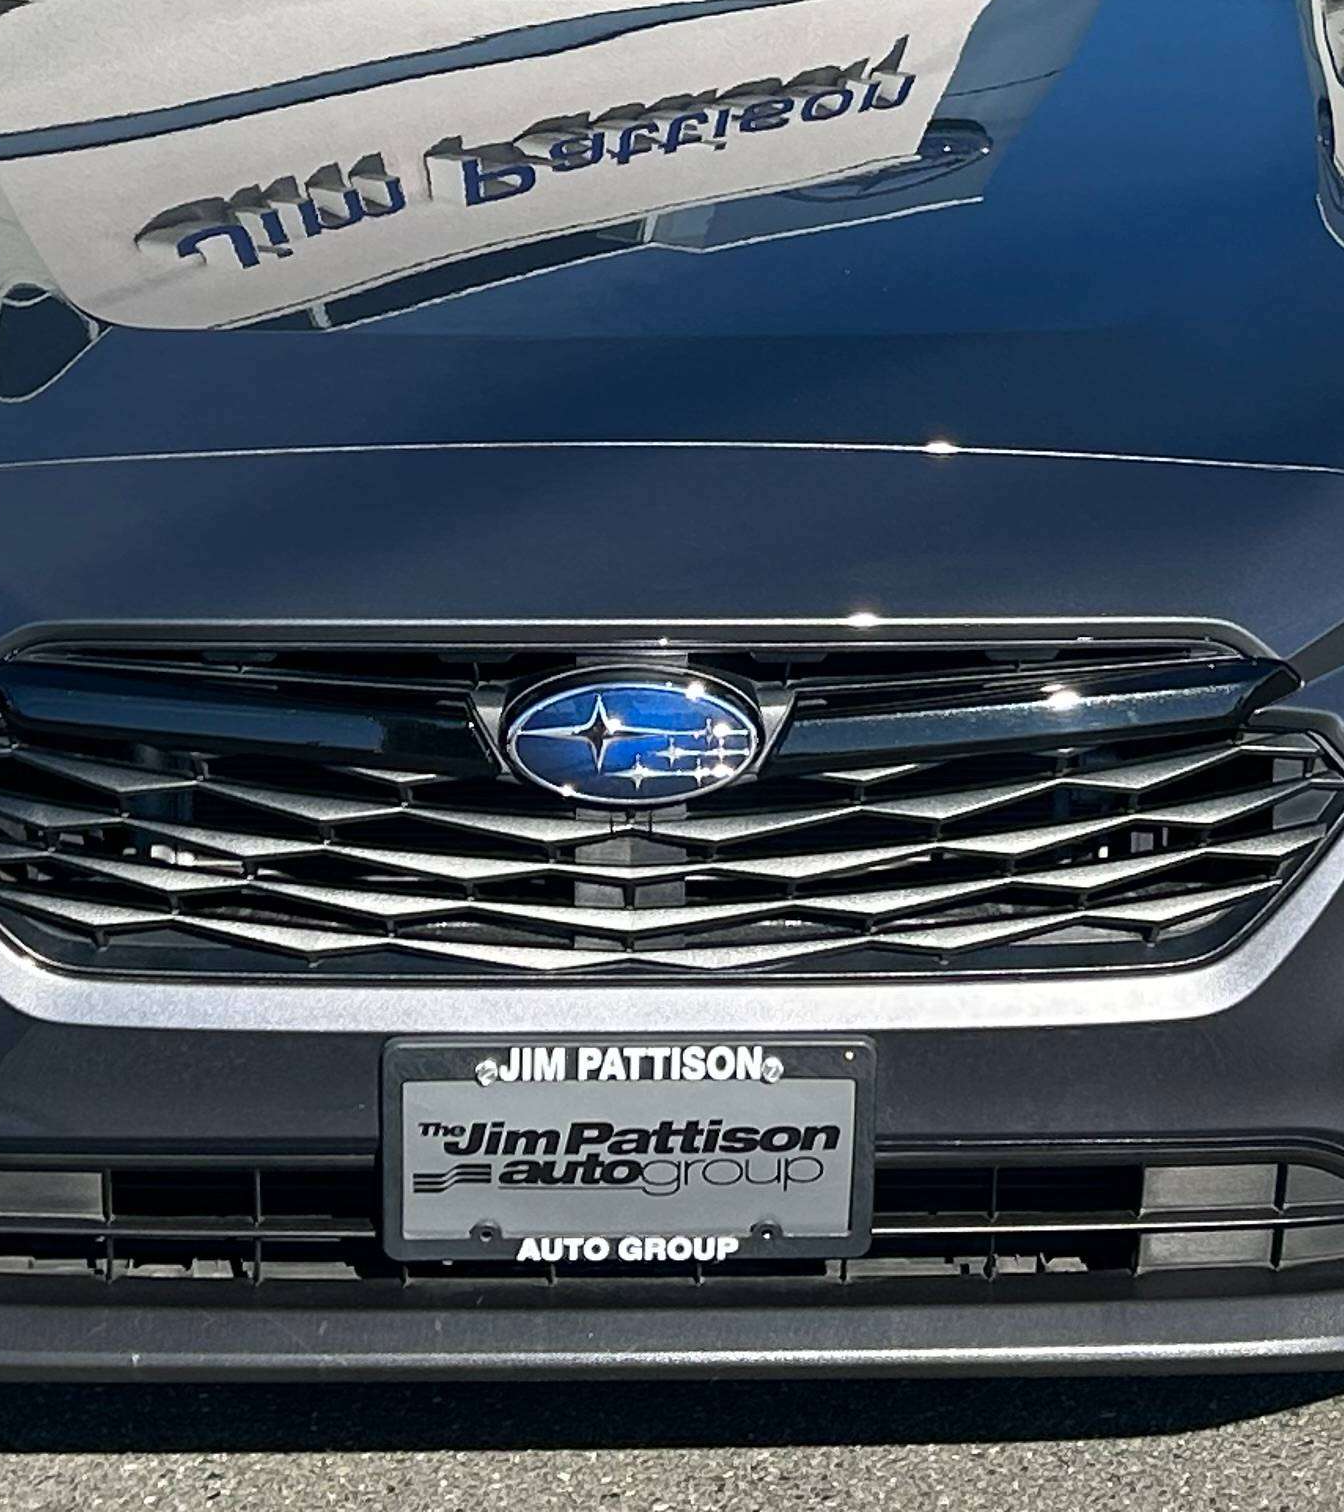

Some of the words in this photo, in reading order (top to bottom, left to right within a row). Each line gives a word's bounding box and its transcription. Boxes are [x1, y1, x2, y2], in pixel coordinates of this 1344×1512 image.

[498, 1046, 567, 1082] JIM
[576, 1045, 764, 1081] PATTISON
[419, 1121, 466, 1138] The
[516, 1237, 611, 1262] AUTO
[617, 1236, 739, 1262] GROUP
